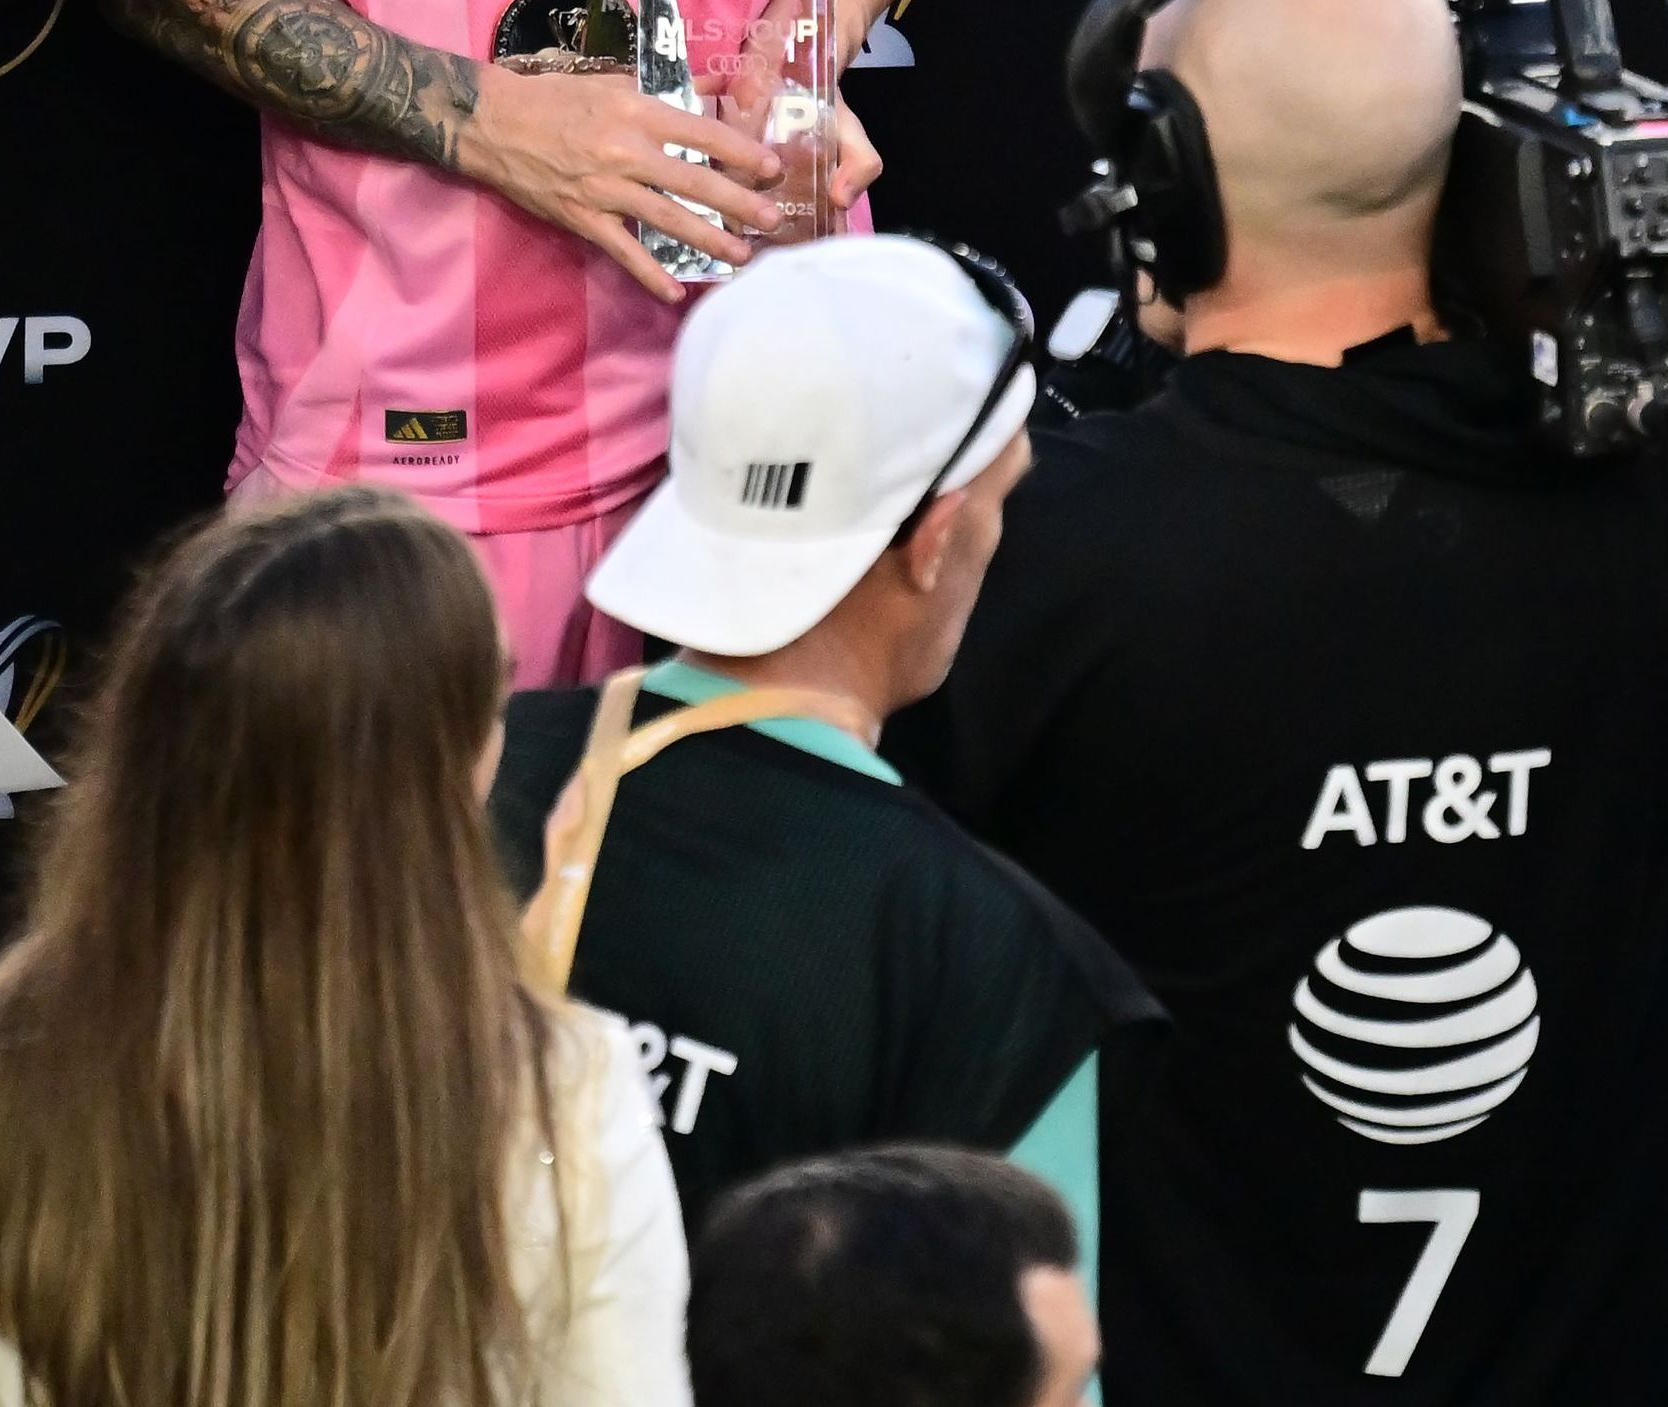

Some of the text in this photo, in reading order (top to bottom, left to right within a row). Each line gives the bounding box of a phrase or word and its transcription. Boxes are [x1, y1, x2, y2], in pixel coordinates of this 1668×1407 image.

[392, 455, 461, 466] AEROREADY
[1300, 747, 1552, 850] AT&T
[1357, 1188, 1481, 1378] 7
